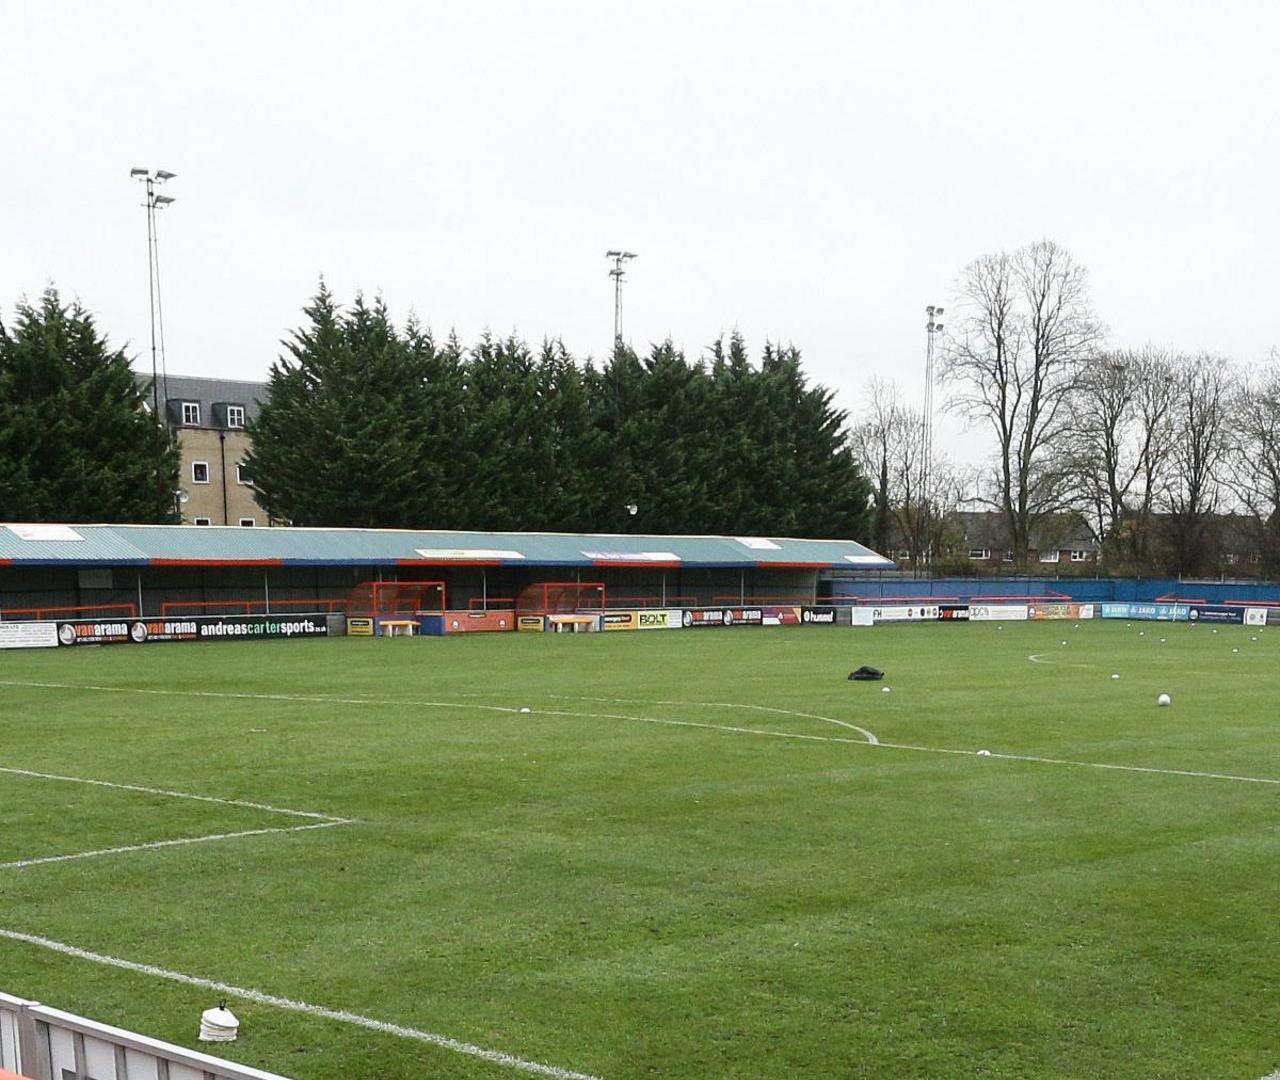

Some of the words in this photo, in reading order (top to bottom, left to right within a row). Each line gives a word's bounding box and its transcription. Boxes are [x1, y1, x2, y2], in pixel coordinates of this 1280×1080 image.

[639, 614, 668, 624] BOLT
[75, 623, 128, 636] vanarama
[147, 622, 197, 635] vanarama
